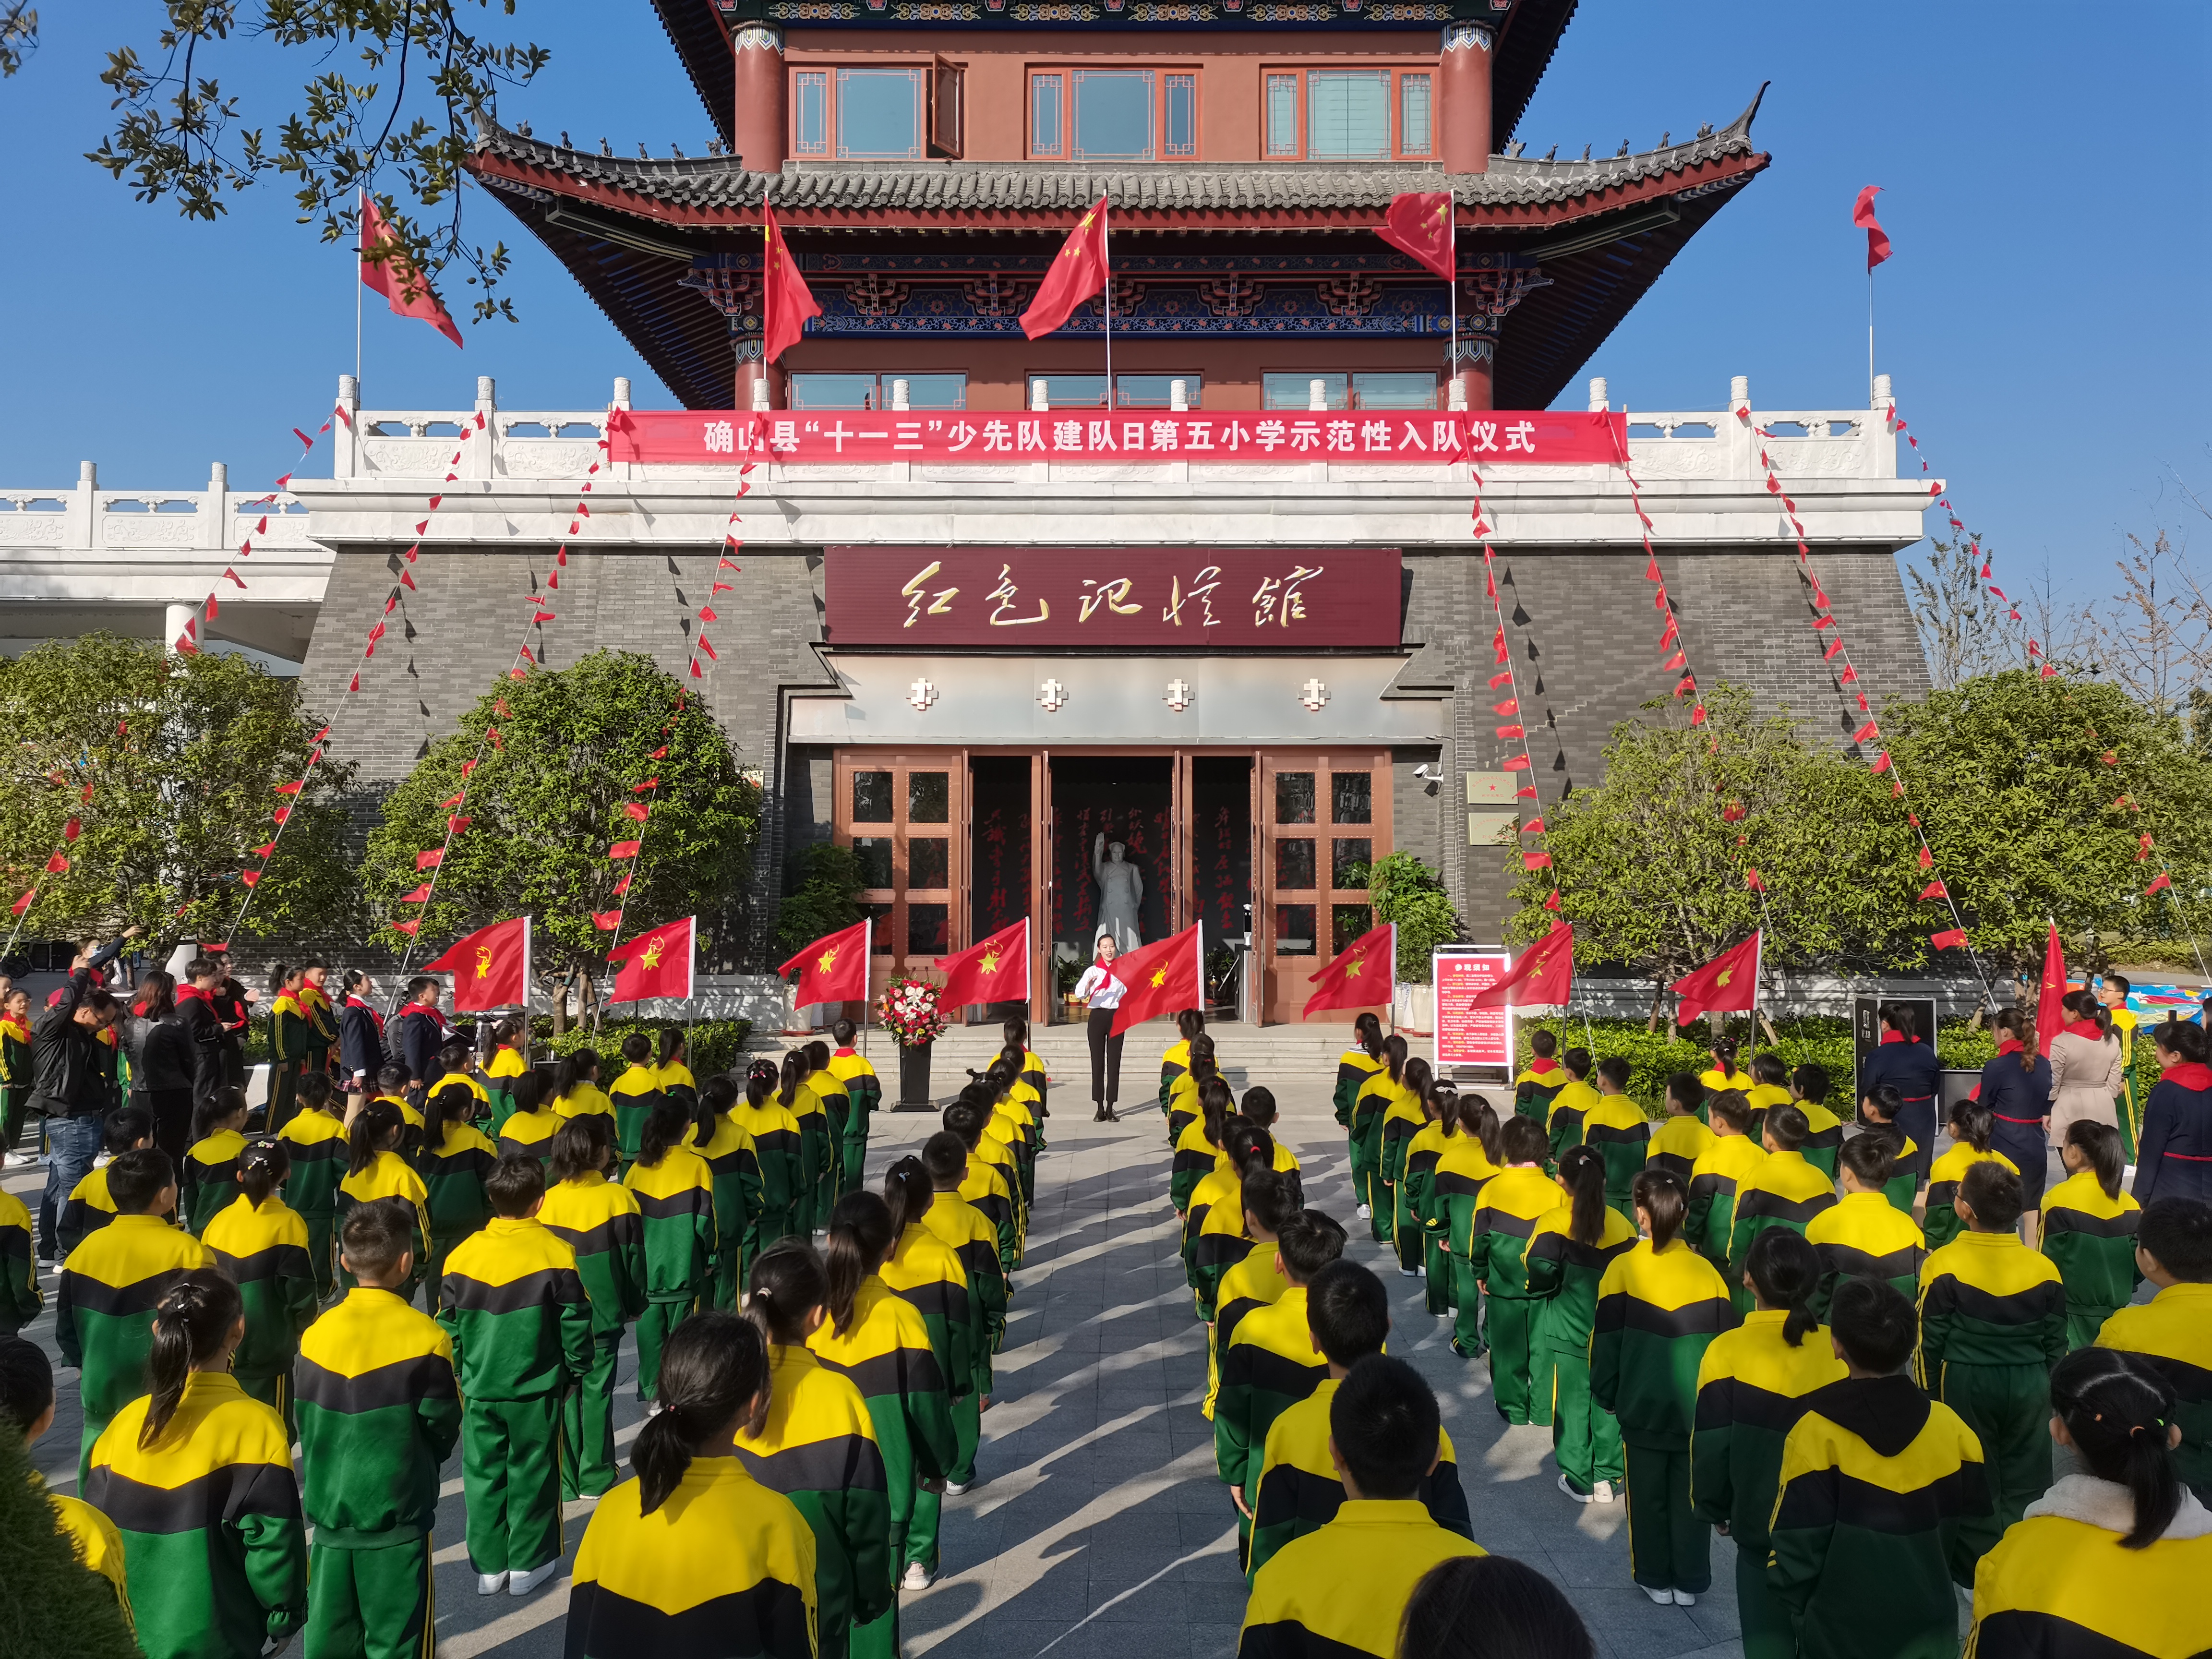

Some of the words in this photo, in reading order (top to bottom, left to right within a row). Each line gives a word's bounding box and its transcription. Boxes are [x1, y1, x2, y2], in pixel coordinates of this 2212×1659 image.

[703, 420, 1535, 453] 确山县“十一三”少先队建队日第五小学示范性入队仪式
